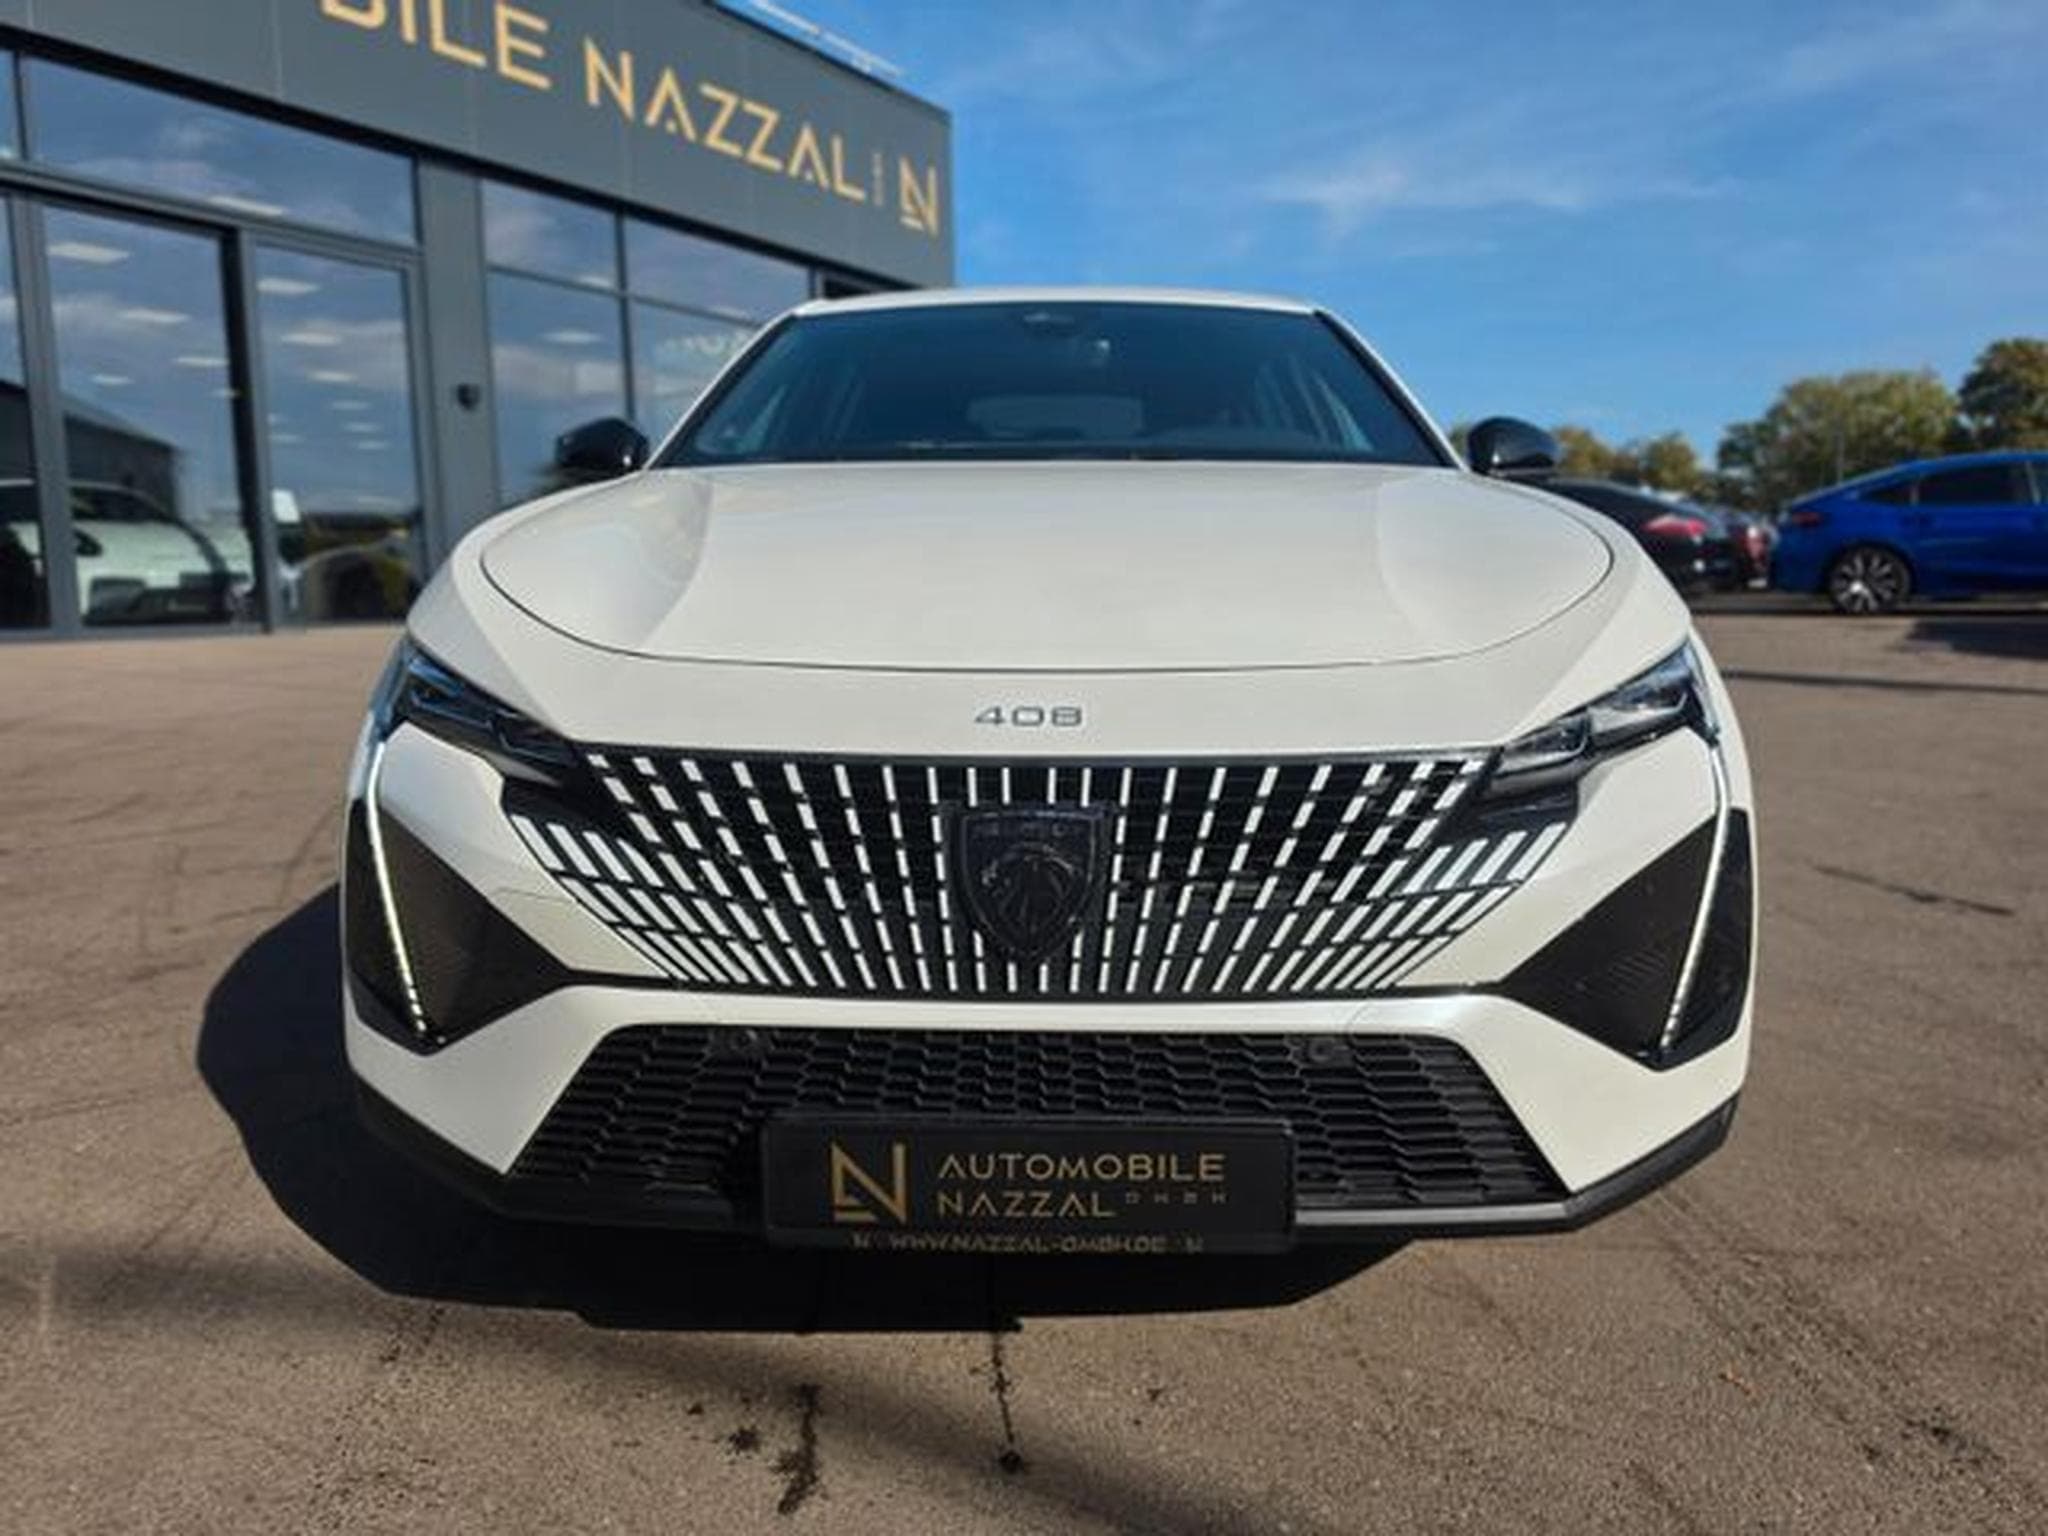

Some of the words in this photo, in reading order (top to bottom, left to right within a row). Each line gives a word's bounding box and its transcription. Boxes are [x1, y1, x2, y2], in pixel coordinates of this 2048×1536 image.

[322, 0, 551, 90] ILE
[585, 37, 866, 201] NAZZAL
[974, 706, 1082, 727] 408
[938, 1153, 1226, 1181] AUTOMOBILE
[938, 1191, 1117, 1218] NAZZAL
